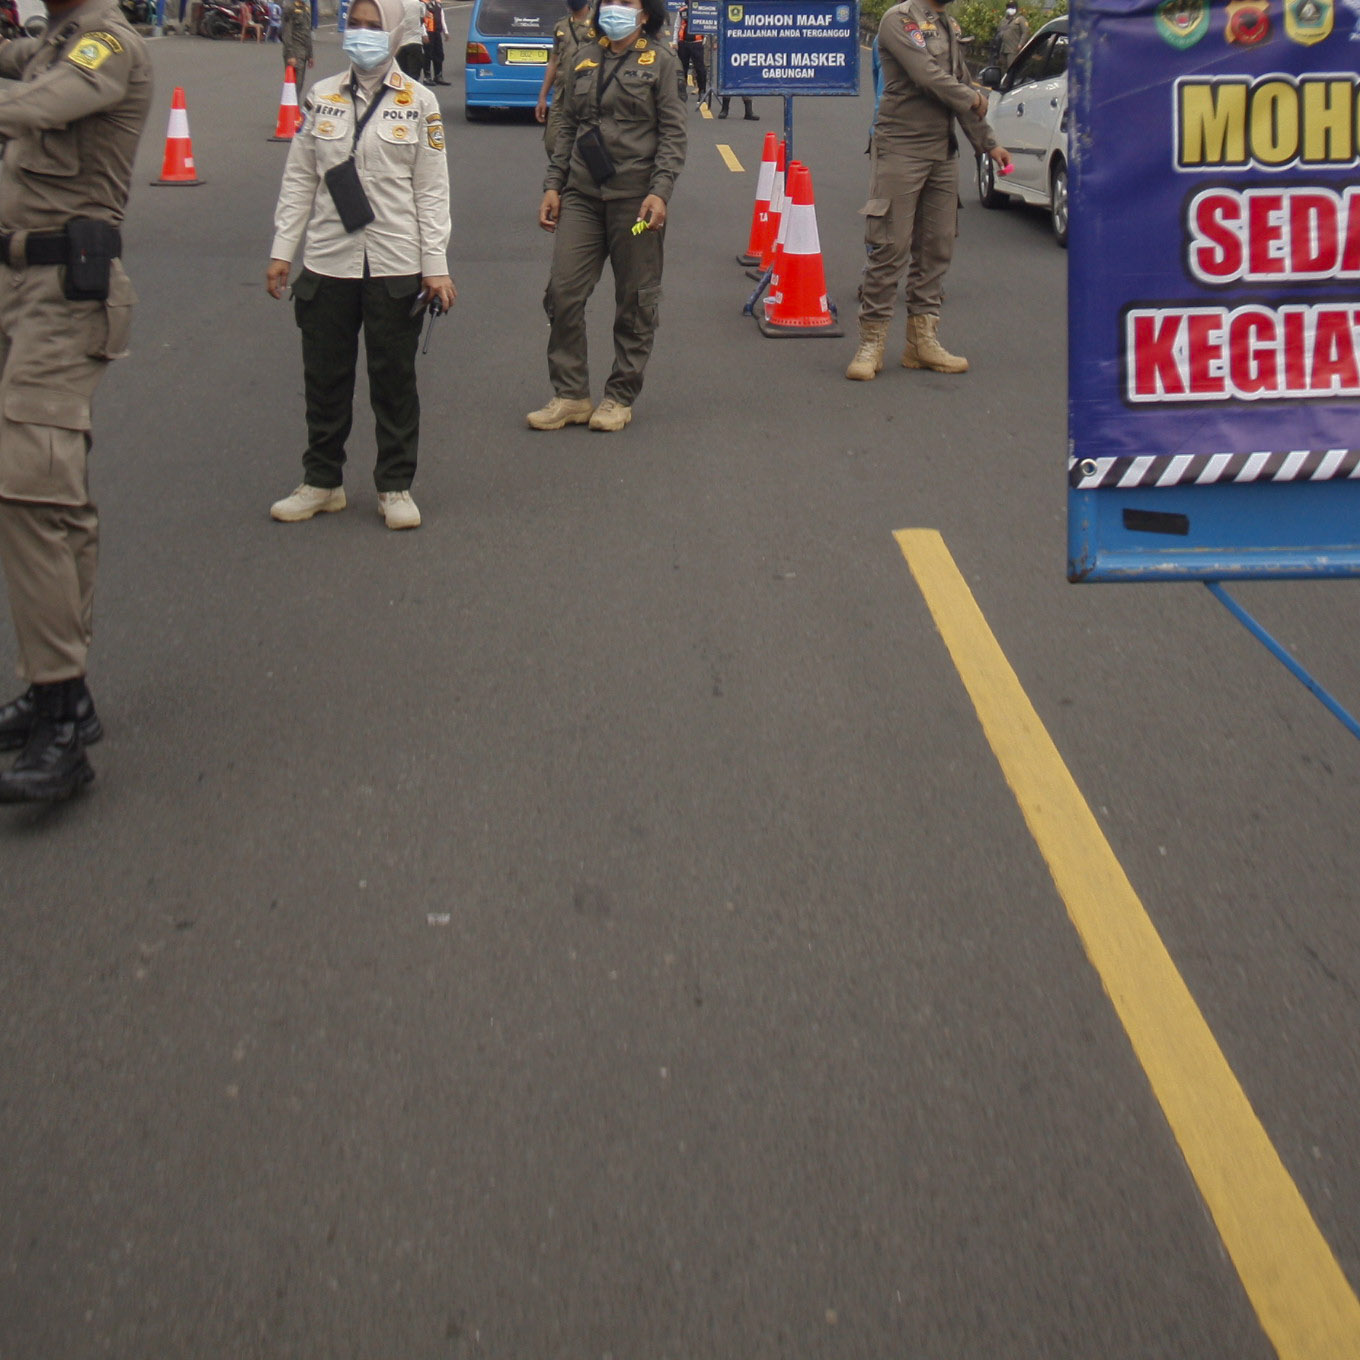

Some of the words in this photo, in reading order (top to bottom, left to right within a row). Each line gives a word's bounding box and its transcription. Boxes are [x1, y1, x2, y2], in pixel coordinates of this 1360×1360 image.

[745, 14, 793, 26] MOHON
[796, 14, 832, 26] MAAF
[727, 29, 778, 38] PERJALANAN
[779, 29, 801, 38] ANDA
[802, 29, 850, 38] TERGANGGU
[731, 53, 787, 66] OPERASI
[791, 53, 846, 66] MASKER
[762, 68, 815, 78] GABUNGAN
[383, 110, 403, 120] POL
[406, 110, 419, 119] PP
